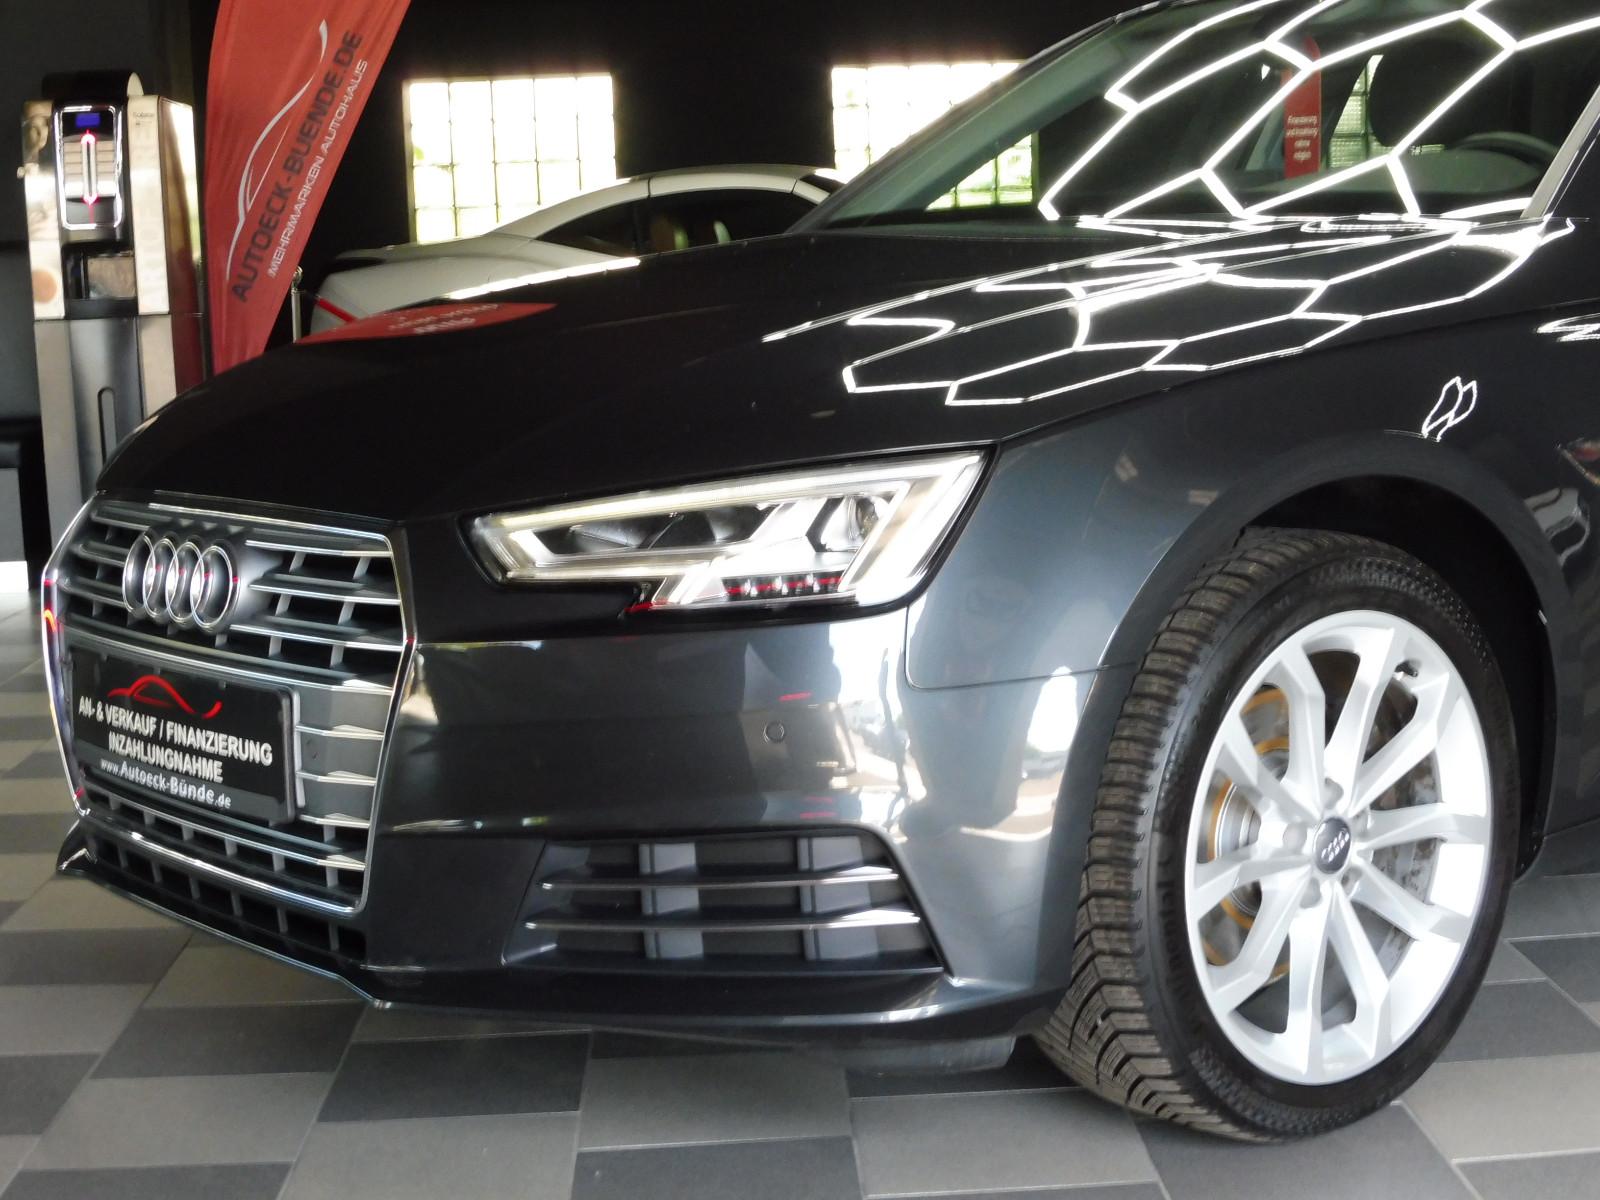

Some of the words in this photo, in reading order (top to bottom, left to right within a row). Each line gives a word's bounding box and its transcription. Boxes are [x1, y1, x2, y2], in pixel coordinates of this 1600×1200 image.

[231, 30, 364, 302] AUTOECK-BUENDE.DE
[267, 155, 325, 278] MEHRMARKEN
[321, 59, 368, 154] AUTOHAUS
[96, 700, 104, 722] &
[104, 703, 158, 738] VERKAUF
[158, 719, 164, 741] /
[166, 720, 273, 767] FINANZIERUNG
[108, 730, 223, 784] INZAHLUNGNAHME
[101, 758, 232, 809] www.Autoeck-Bünde.de
